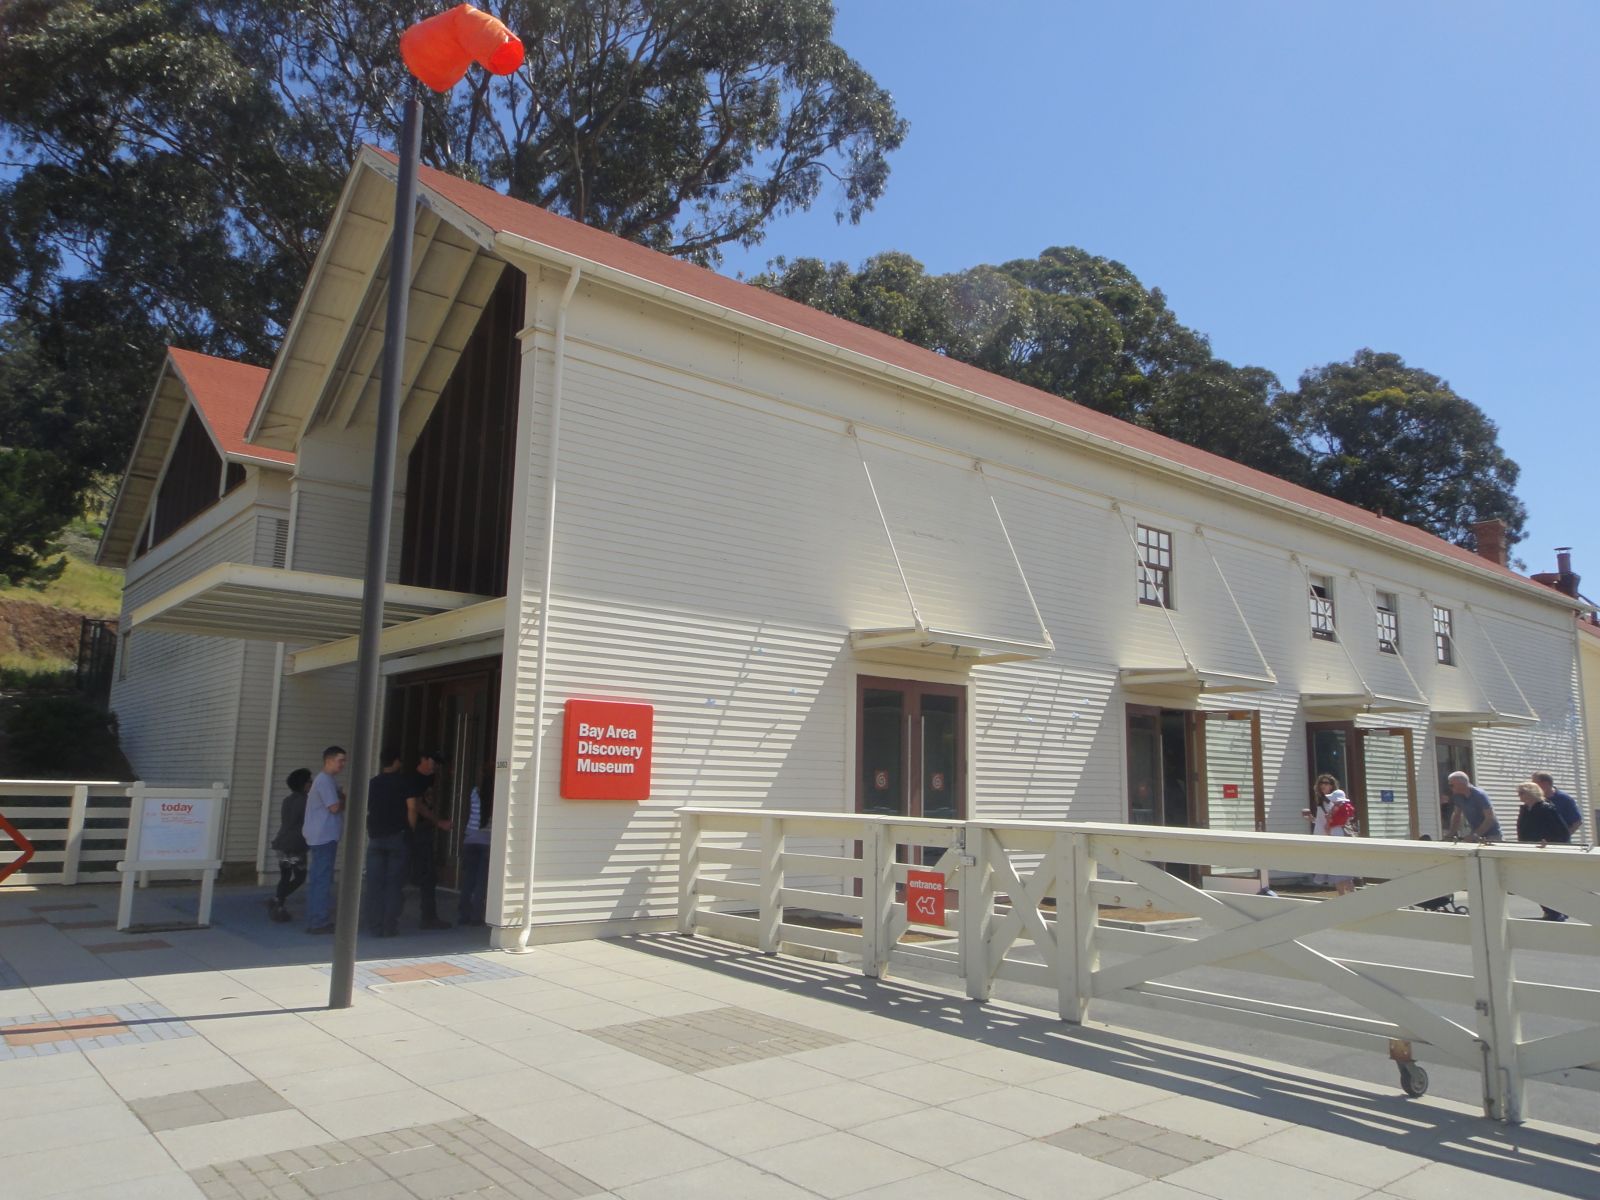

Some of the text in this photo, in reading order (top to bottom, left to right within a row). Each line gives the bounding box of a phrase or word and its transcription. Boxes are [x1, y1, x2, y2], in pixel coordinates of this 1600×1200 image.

[579, 723, 637, 740] Bay Area
[578, 741, 643, 760] Discovery
[577, 758, 635, 774] Museum
[161, 803, 193, 814] today
[909, 880, 942, 891] entrance
